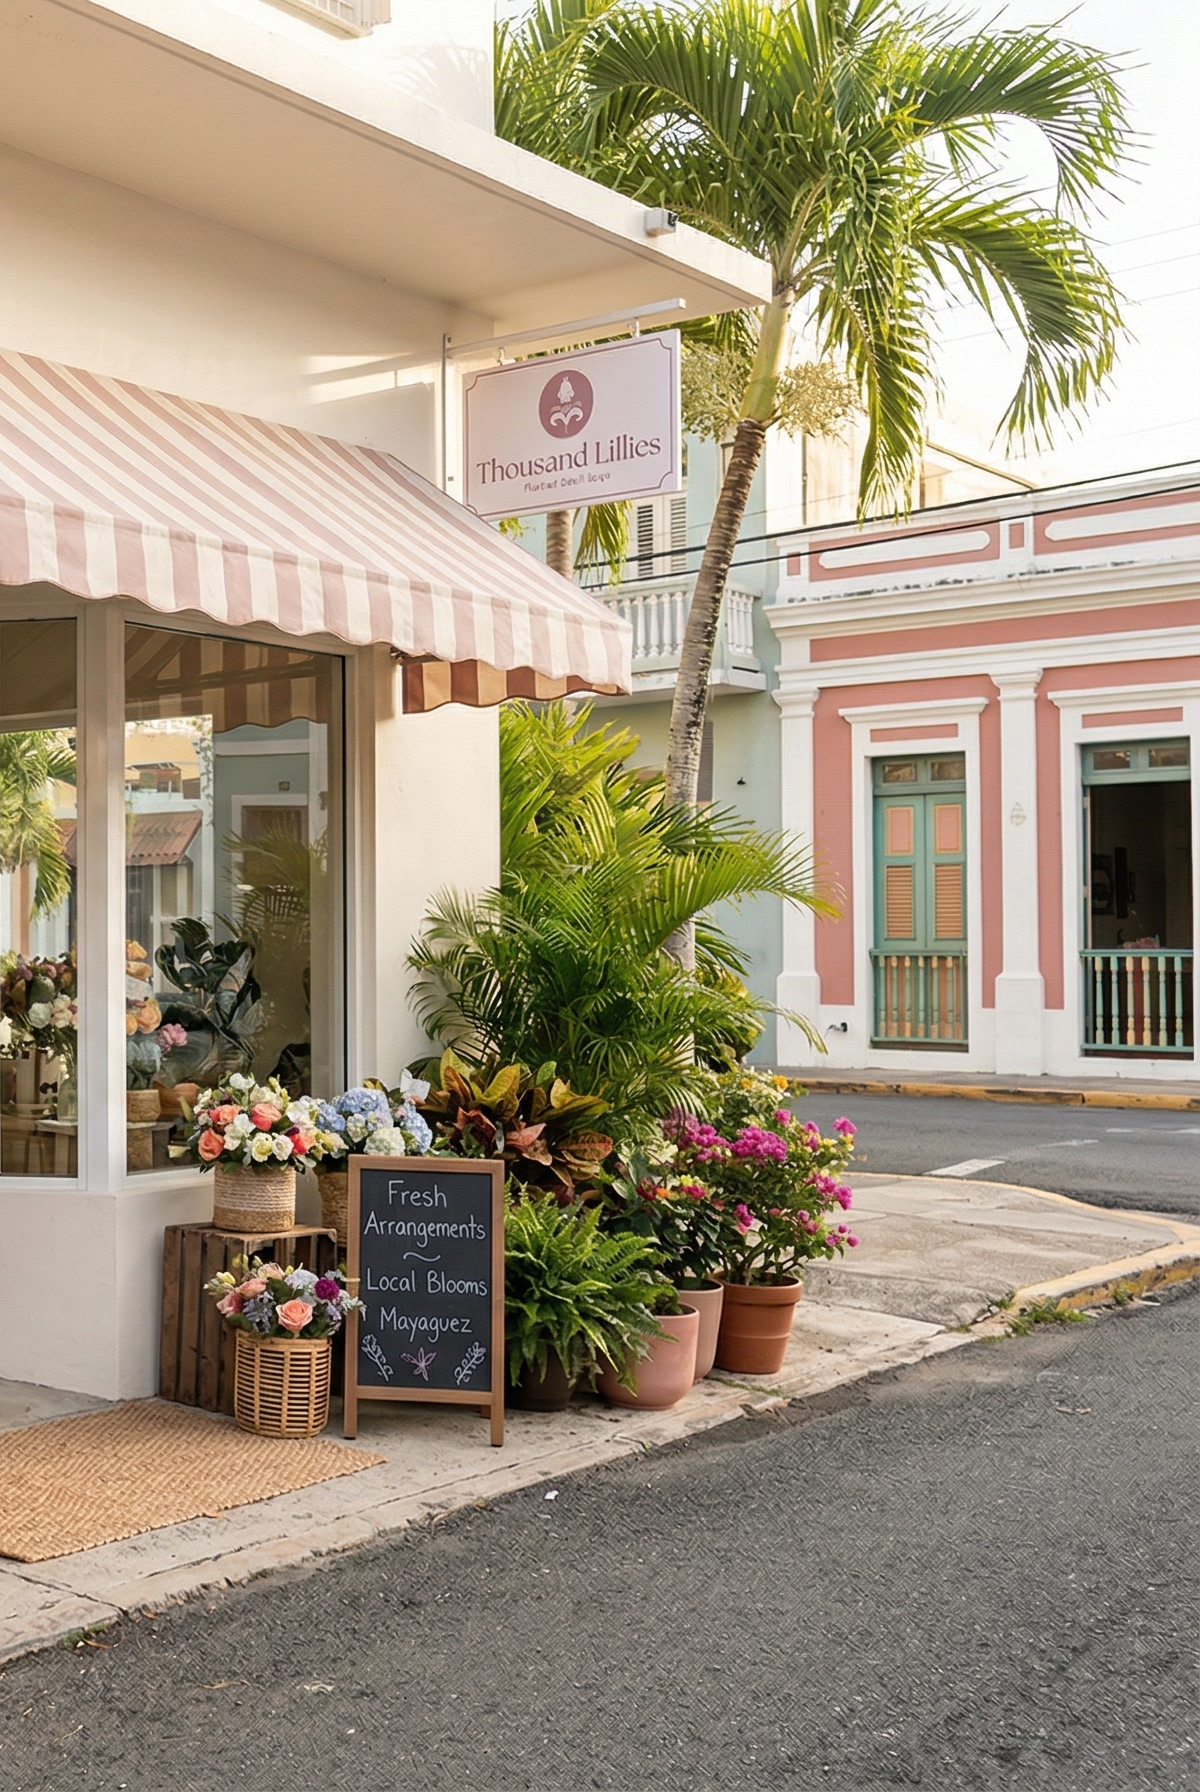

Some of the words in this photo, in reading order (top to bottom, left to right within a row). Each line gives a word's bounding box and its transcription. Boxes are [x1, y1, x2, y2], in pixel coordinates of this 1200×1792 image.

[476, 441, 588, 484] Thousand
[595, 434, 661, 464] Lillies
[388, 1179, 447, 1208] Fresh
[364, 1211, 486, 1248] Arrangements
[367, 1267, 416, 1292] Local
[427, 1270, 488, 1296] Blooms
[380, 1306, 472, 1343] Mayaguez
